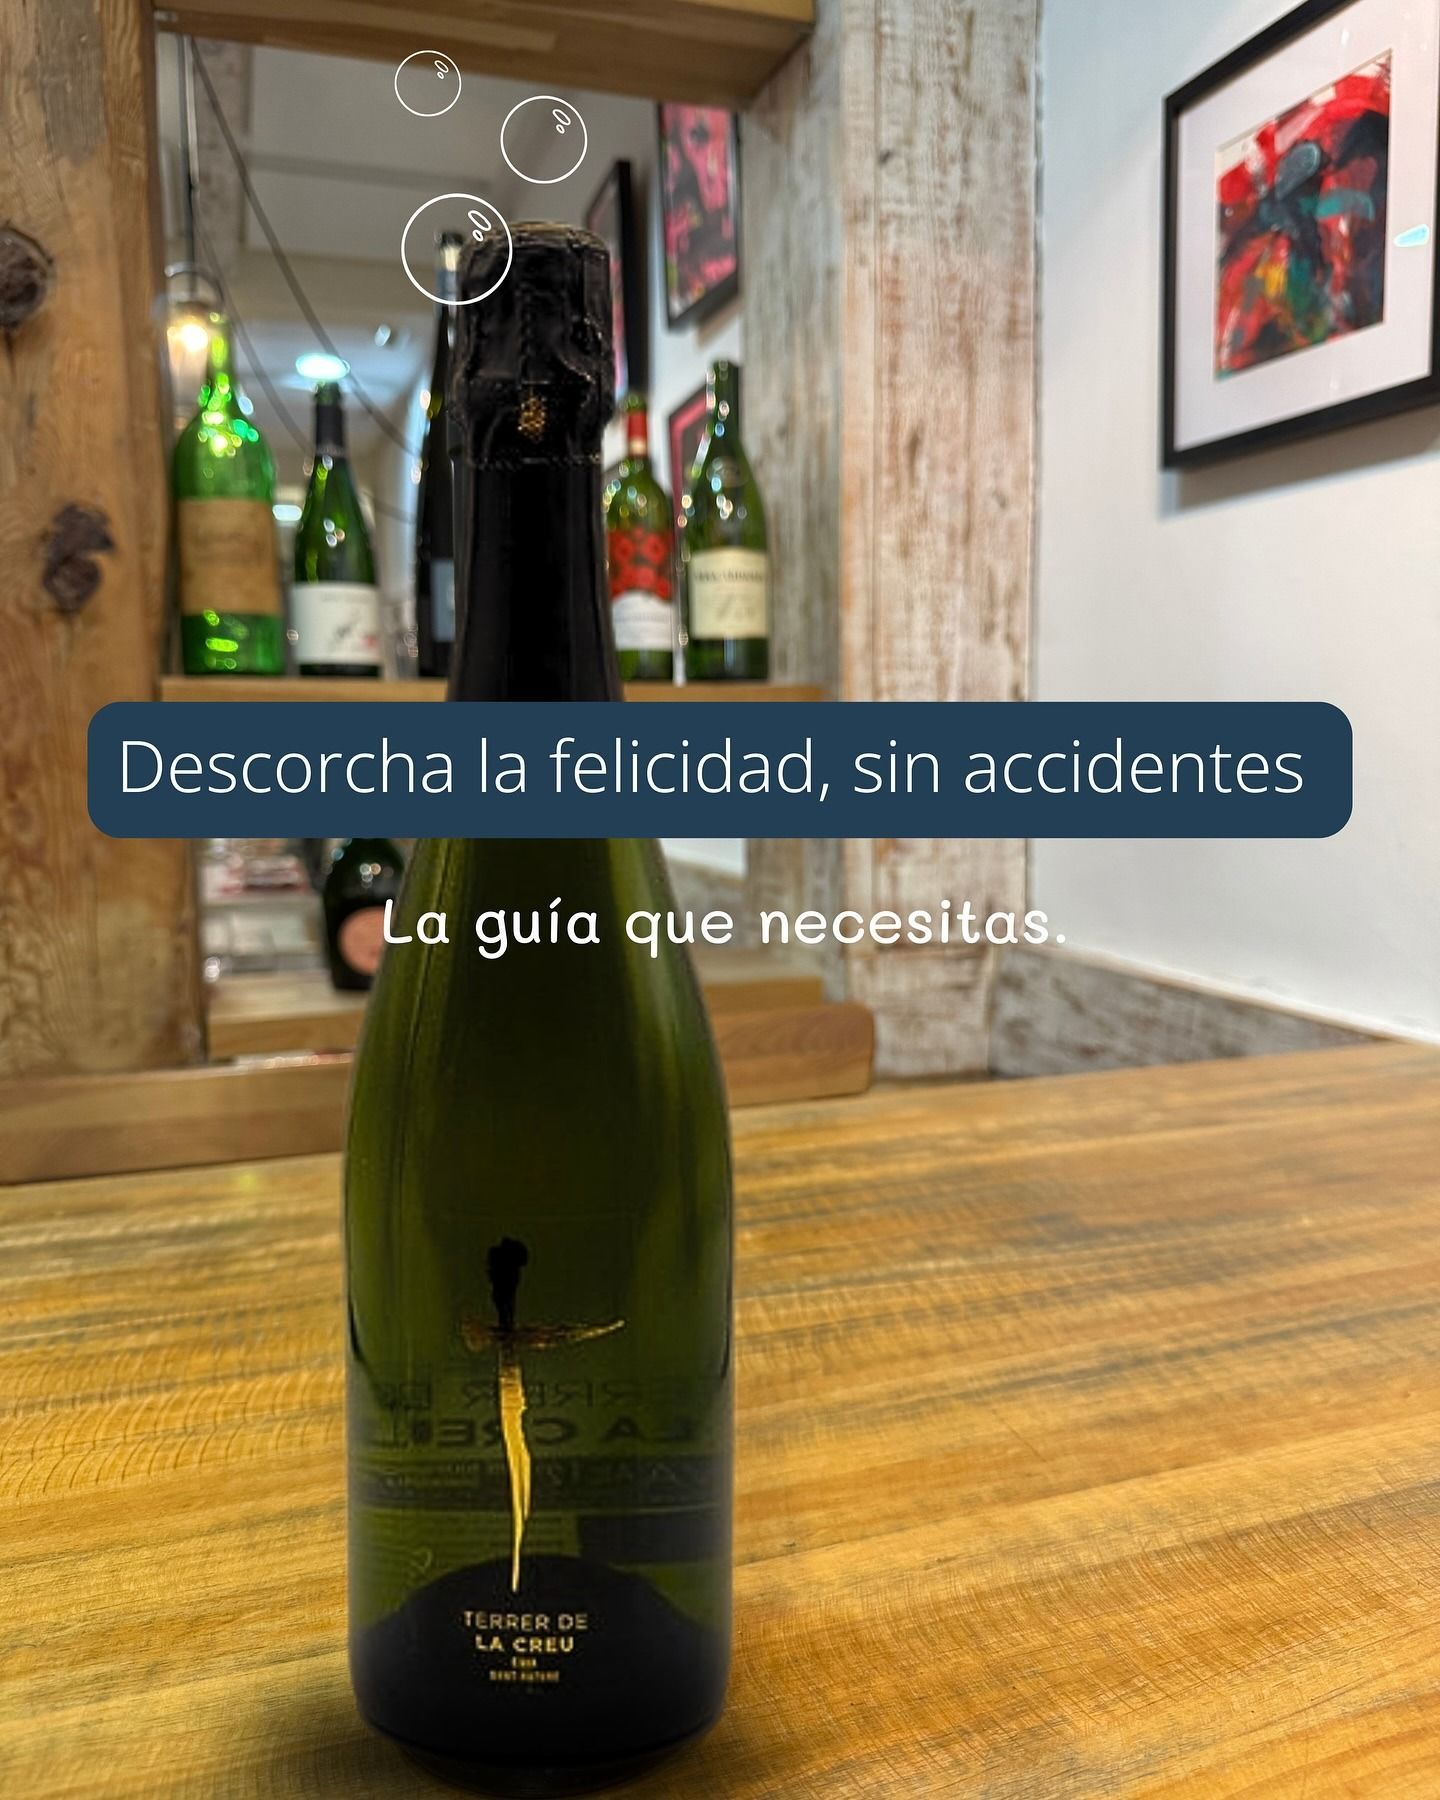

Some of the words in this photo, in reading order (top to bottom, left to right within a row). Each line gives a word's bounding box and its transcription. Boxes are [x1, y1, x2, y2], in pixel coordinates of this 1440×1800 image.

[464, 1611, 550, 1631] TERRER
[557, 1613, 588, 1630] DE
[475, 1634, 504, 1652] LA
[512, 1636, 574, 1653] CREU
